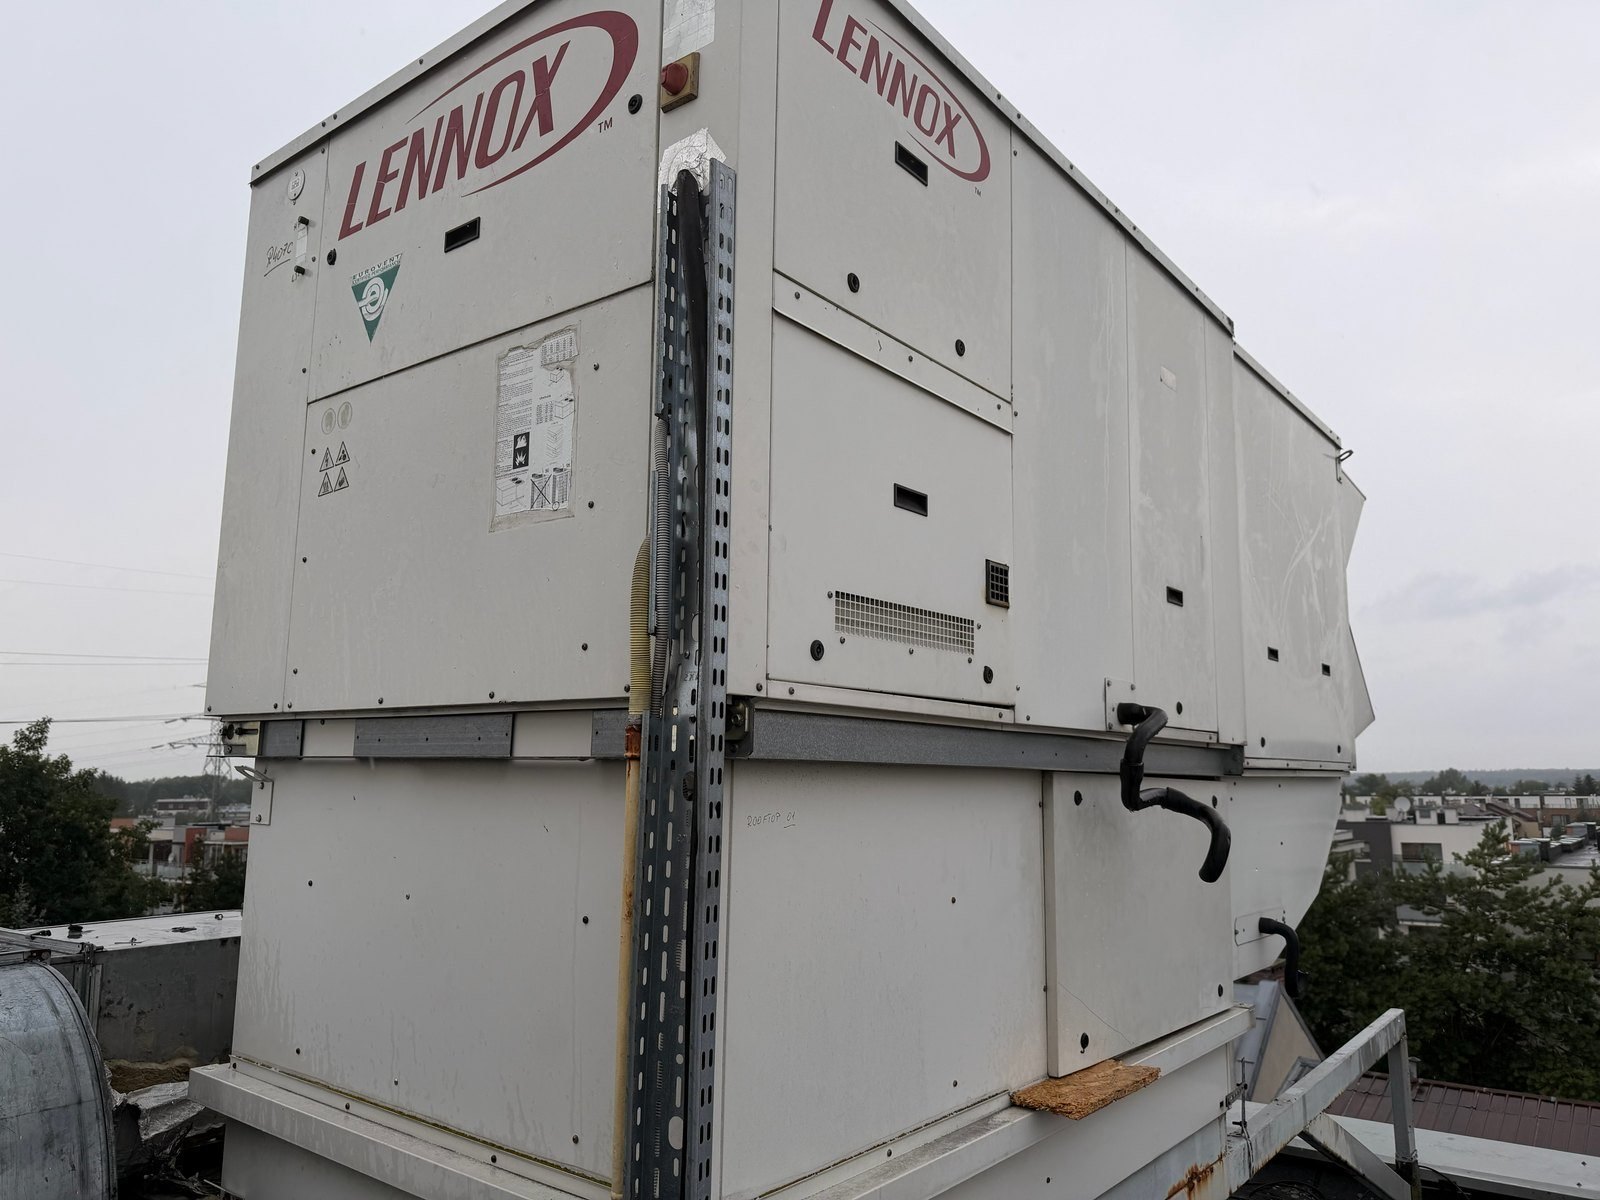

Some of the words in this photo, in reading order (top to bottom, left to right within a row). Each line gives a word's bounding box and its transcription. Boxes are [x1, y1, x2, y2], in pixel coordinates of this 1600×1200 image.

[598, 117, 612, 133] TM
[812, 0, 962, 159] LENNOX
[338, 40, 571, 241] LENNOX
[352, 253, 402, 280] EUROVENT
